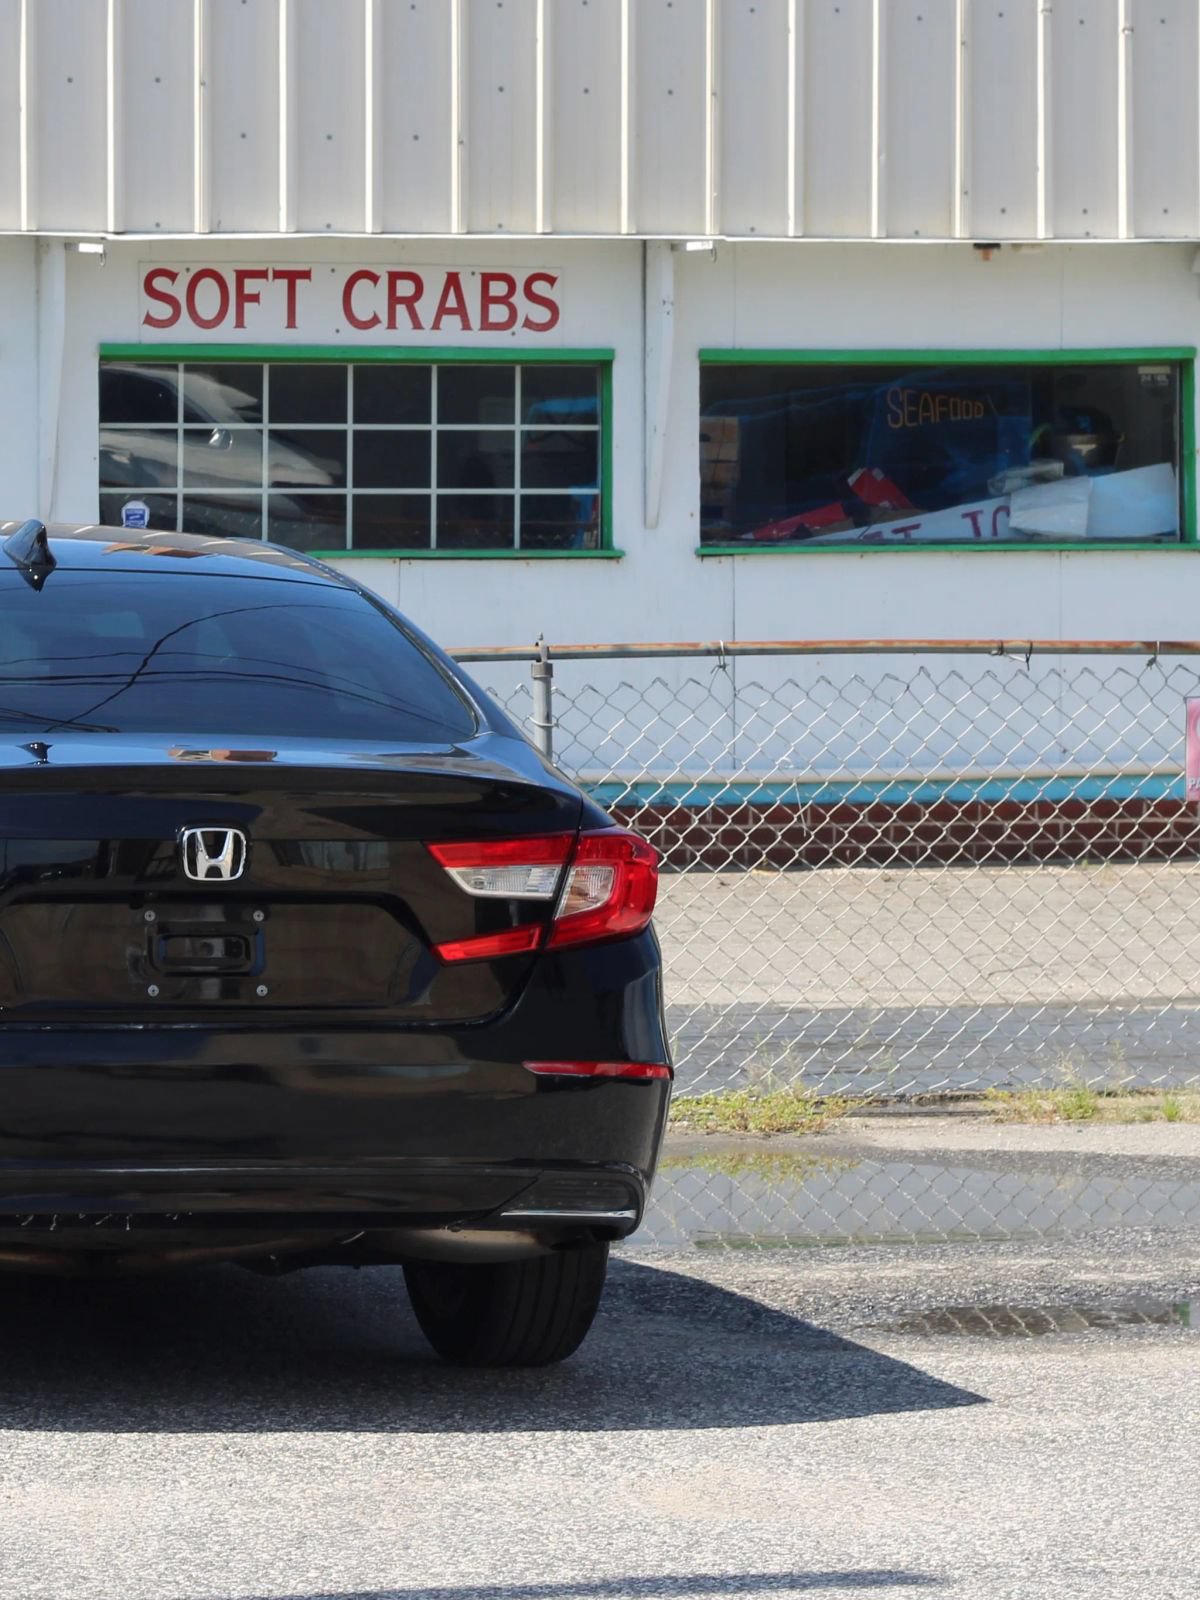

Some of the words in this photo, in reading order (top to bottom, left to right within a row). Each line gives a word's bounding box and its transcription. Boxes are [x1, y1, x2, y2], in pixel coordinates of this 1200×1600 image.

[142, 267, 312, 329] SOFT
[342, 269, 560, 332] CRABS
[886, 386, 985, 429] SEAFOOD
